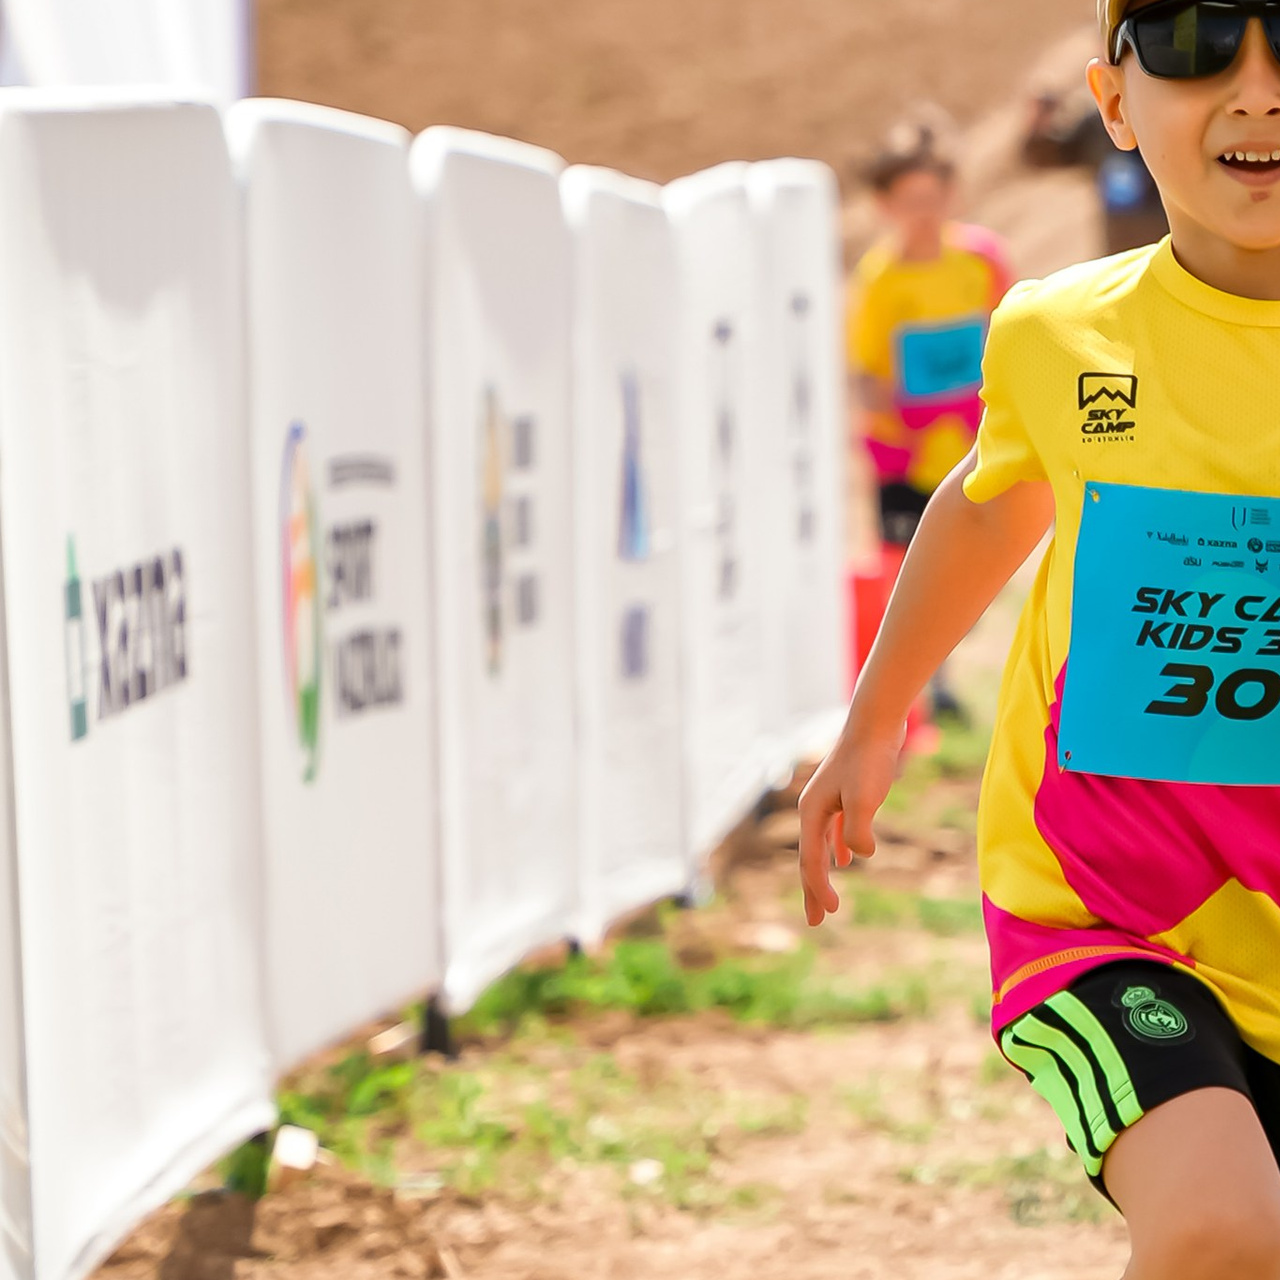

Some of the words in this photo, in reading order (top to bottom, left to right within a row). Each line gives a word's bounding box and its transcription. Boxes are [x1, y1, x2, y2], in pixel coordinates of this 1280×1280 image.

[1087, 408, 1127, 421] SKY
[1081, 421, 1136, 435] CAMP
[1206, 539, 1238, 549] xazna
[1131, 586, 1226, 619] SKY
[92, 544, 190, 726] xazna
[1136, 620, 1249, 654] KIDS
